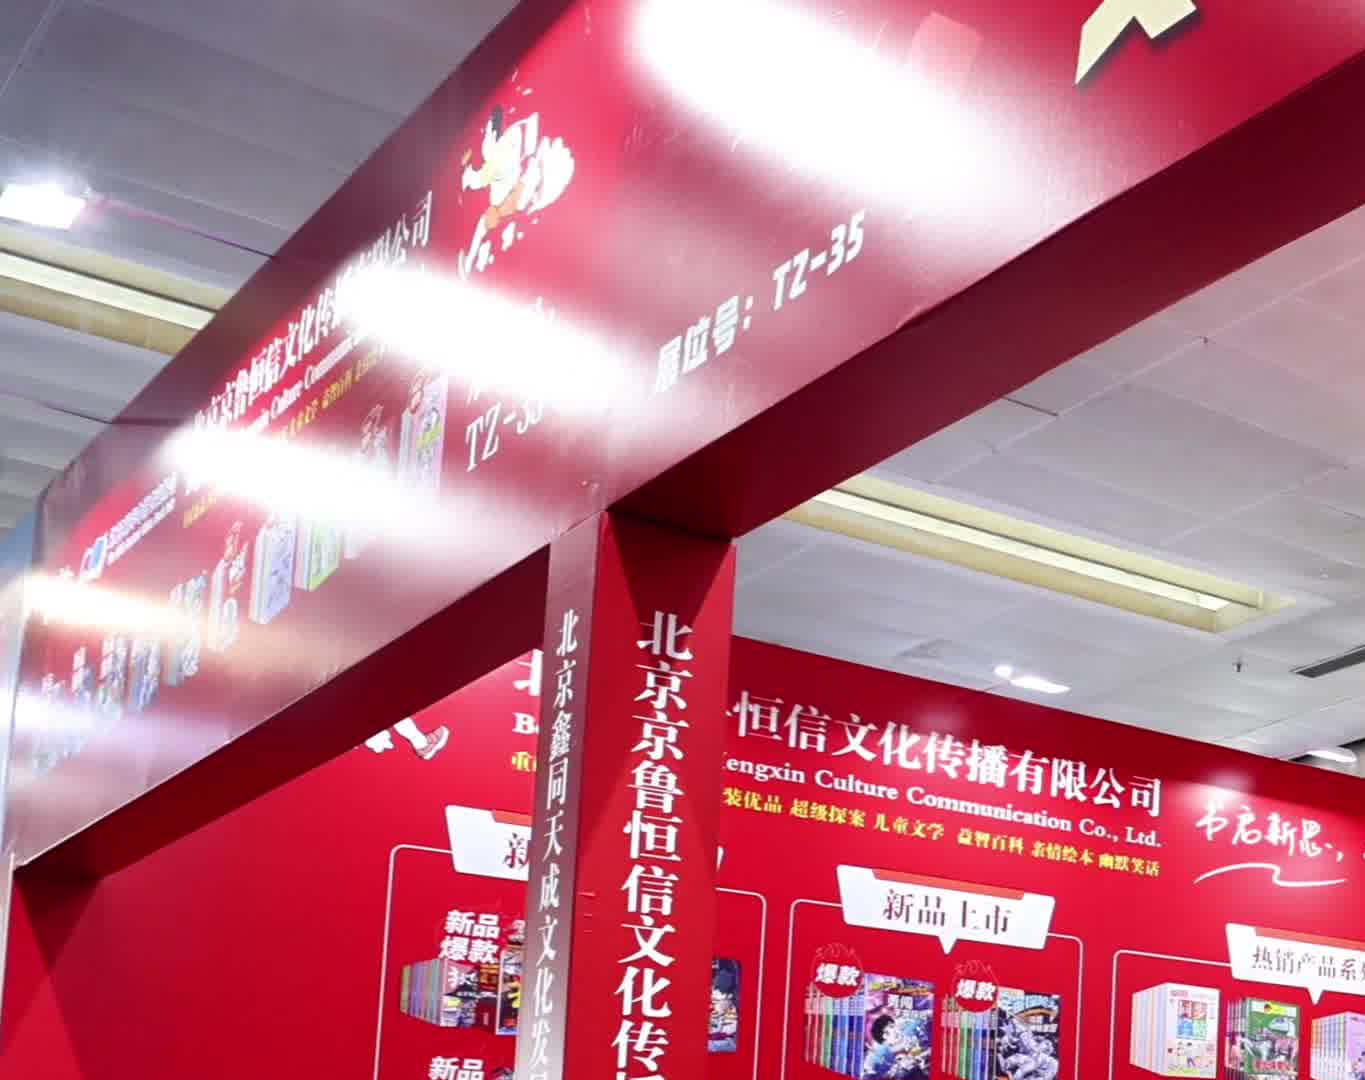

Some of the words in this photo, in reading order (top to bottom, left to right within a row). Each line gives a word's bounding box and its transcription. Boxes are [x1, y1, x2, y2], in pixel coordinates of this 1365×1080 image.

[772, 209, 865, 312] TZ-35
[722, 752, 807, 785] engxin
[814, 769, 899, 802] Culture
[906, 785, 1072, 833] Communication
[1079, 818, 1120, 843] Co.,
[1125, 824, 1162, 849] Ltd.
[789, 800, 866, 830] 超级探案
[873, 811, 945, 841] 儿童文学
[1099, 852, 1161, 879] 幽默笑话
[444, 909, 500, 938] 新品
[883, 887, 1014, 936] 新品上市
[439, 936, 499, 964] 爆款
[816, 963, 860, 986] 爆款
[955, 978, 996, 1001] 爆款
